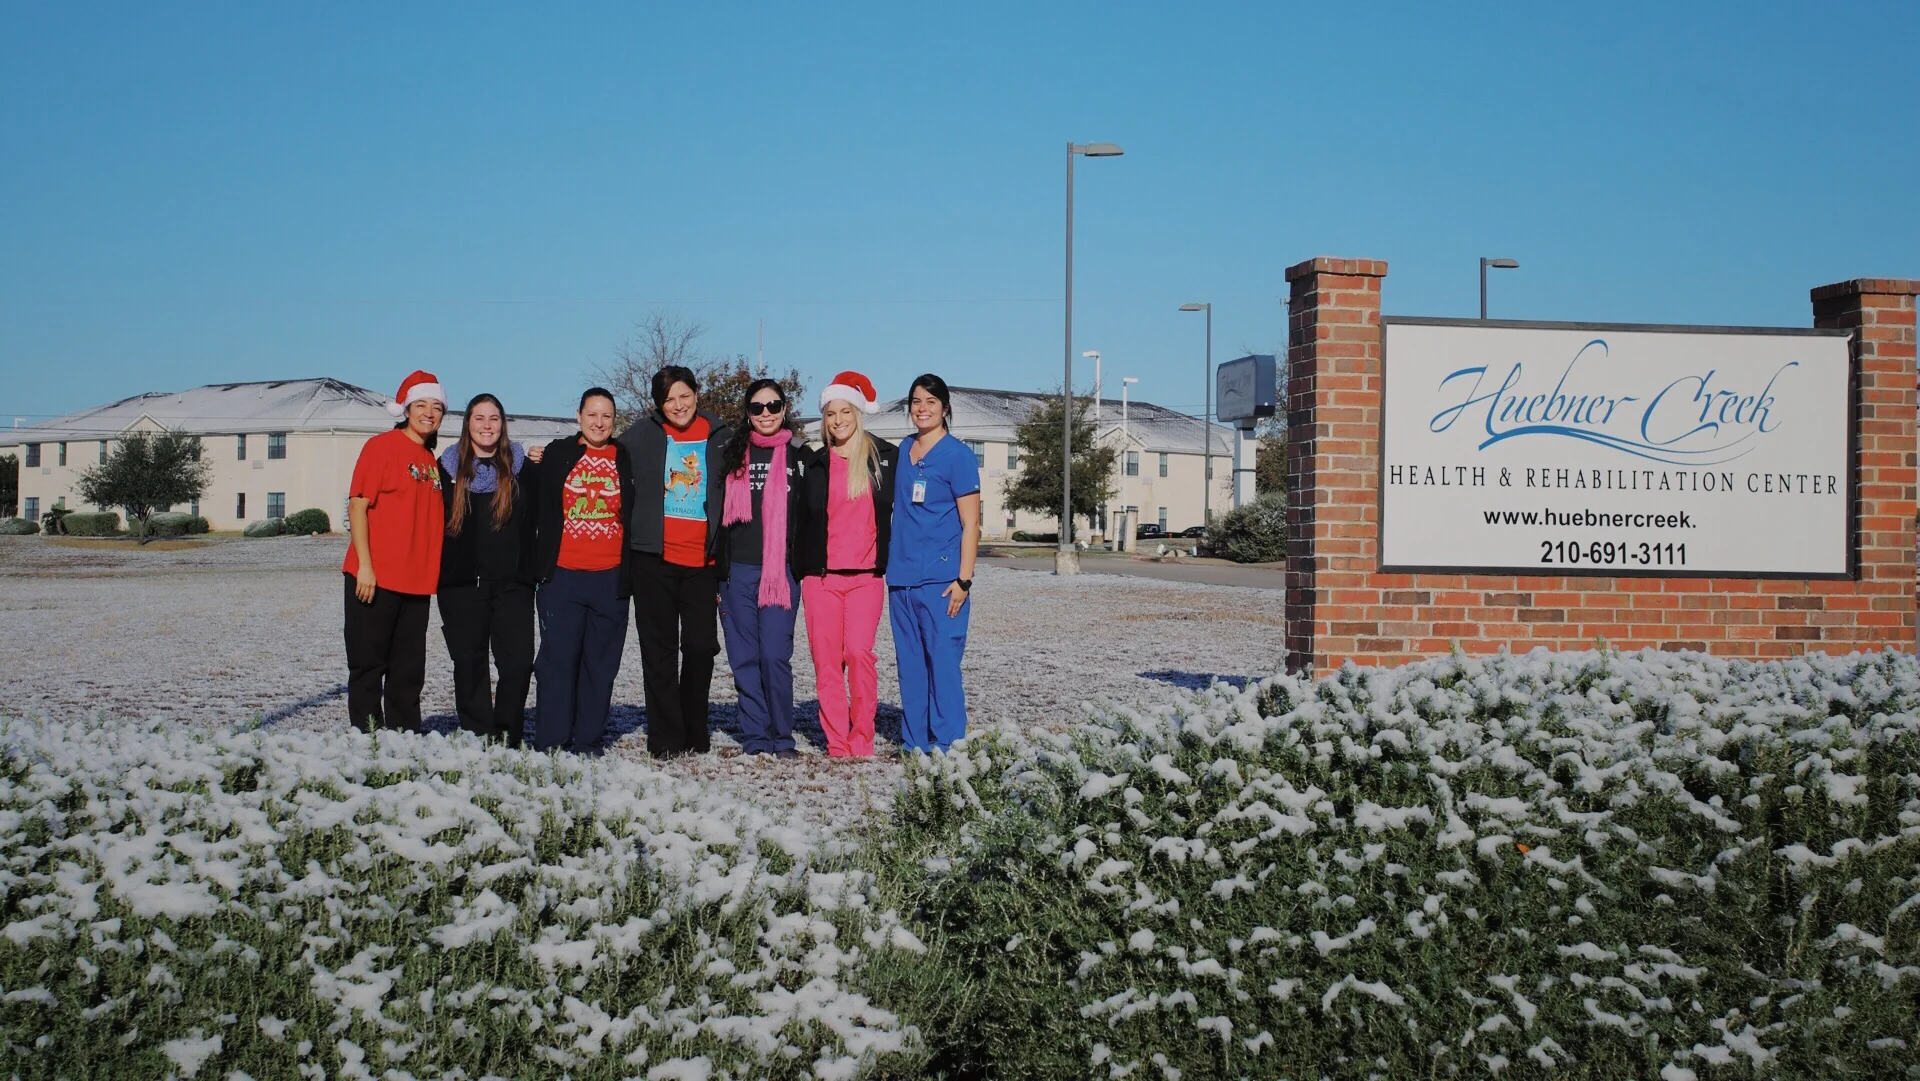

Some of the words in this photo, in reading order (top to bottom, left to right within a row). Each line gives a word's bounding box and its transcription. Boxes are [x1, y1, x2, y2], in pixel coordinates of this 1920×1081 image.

[1430, 339, 1640, 436] Huebner
[1641, 362, 1799, 445] Creek
[1390, 465, 1486, 487] HEALTH
[1499, 467, 1512, 487] &
[1526, 468, 1734, 492] REHABILITATION
[1747, 472, 1838, 495] CENTER
[672, 507, 697, 515] VENADO
[1483, 507, 1697, 529] www.huebnercreek.
[1540, 540, 1686, 565] 210-691-3111
